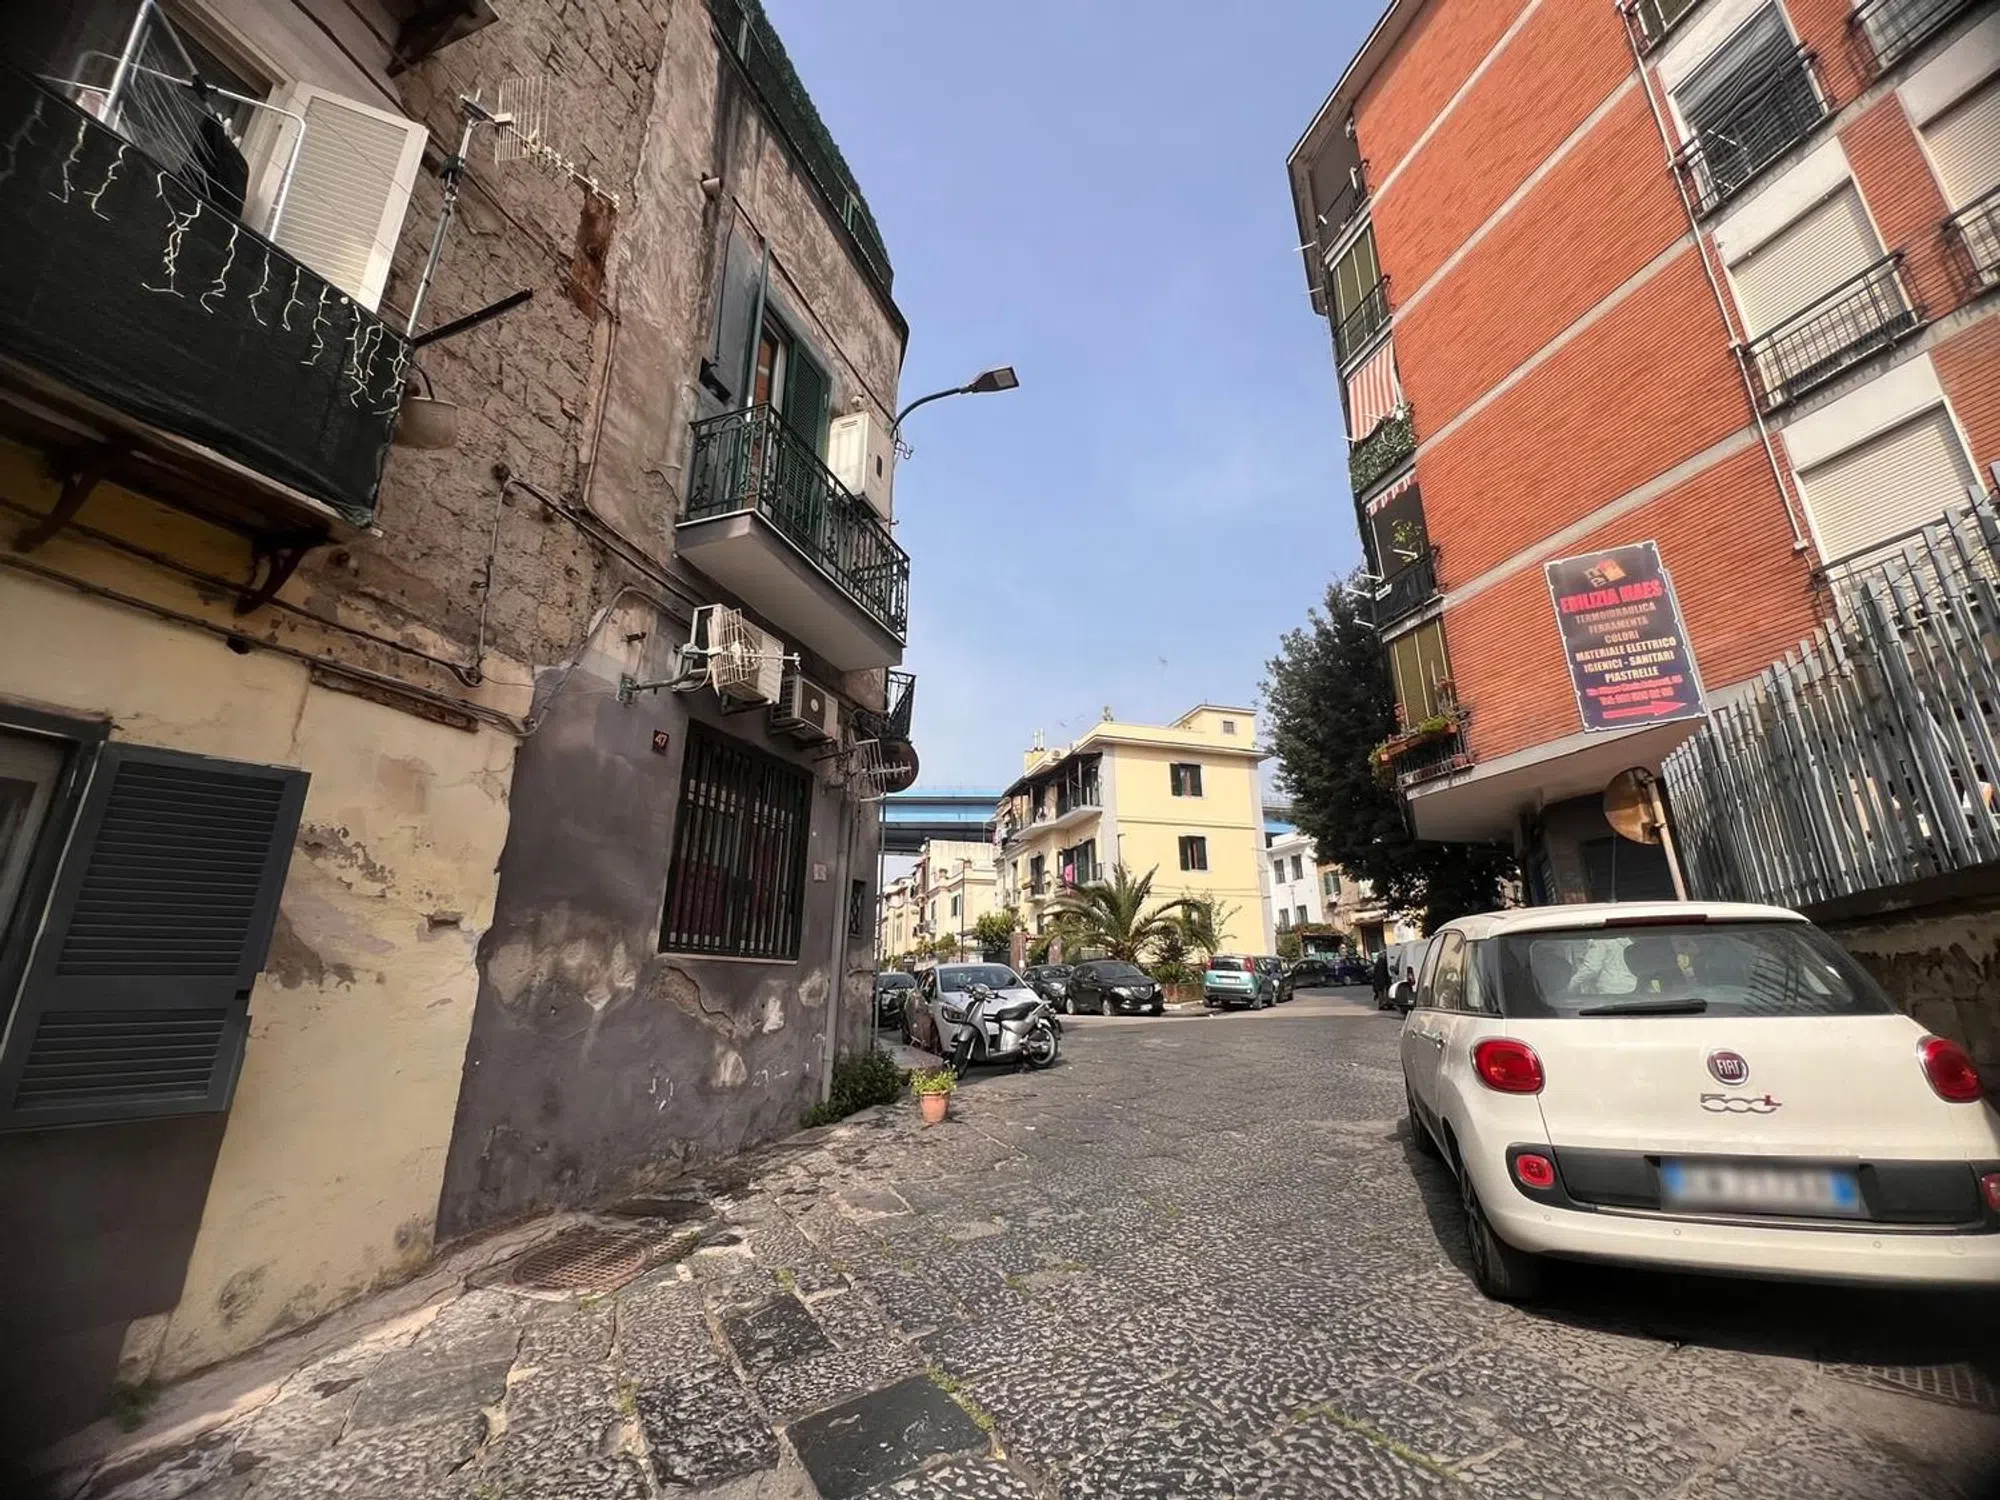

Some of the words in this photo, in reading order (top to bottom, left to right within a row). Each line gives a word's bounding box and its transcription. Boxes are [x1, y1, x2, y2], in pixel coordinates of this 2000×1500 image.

[1575, 602, 1656, 624] TERMOIDRAULICA
[1604, 630, 1640, 644] COLORI
[1575, 646, 1626, 662] MATERIALE
[1625, 636, 1677, 654] ELETTRICO
[1583, 658, 1623, 673] IGIENICI
[1628, 650, 1675, 667] SANITARI
[1604, 666, 1660, 684] PIASTRELLE
[655, 733, 668, 747] 47
[1715, 1059, 1740, 1075] FIAT
[1700, 1093, 1782, 1114] 500L
